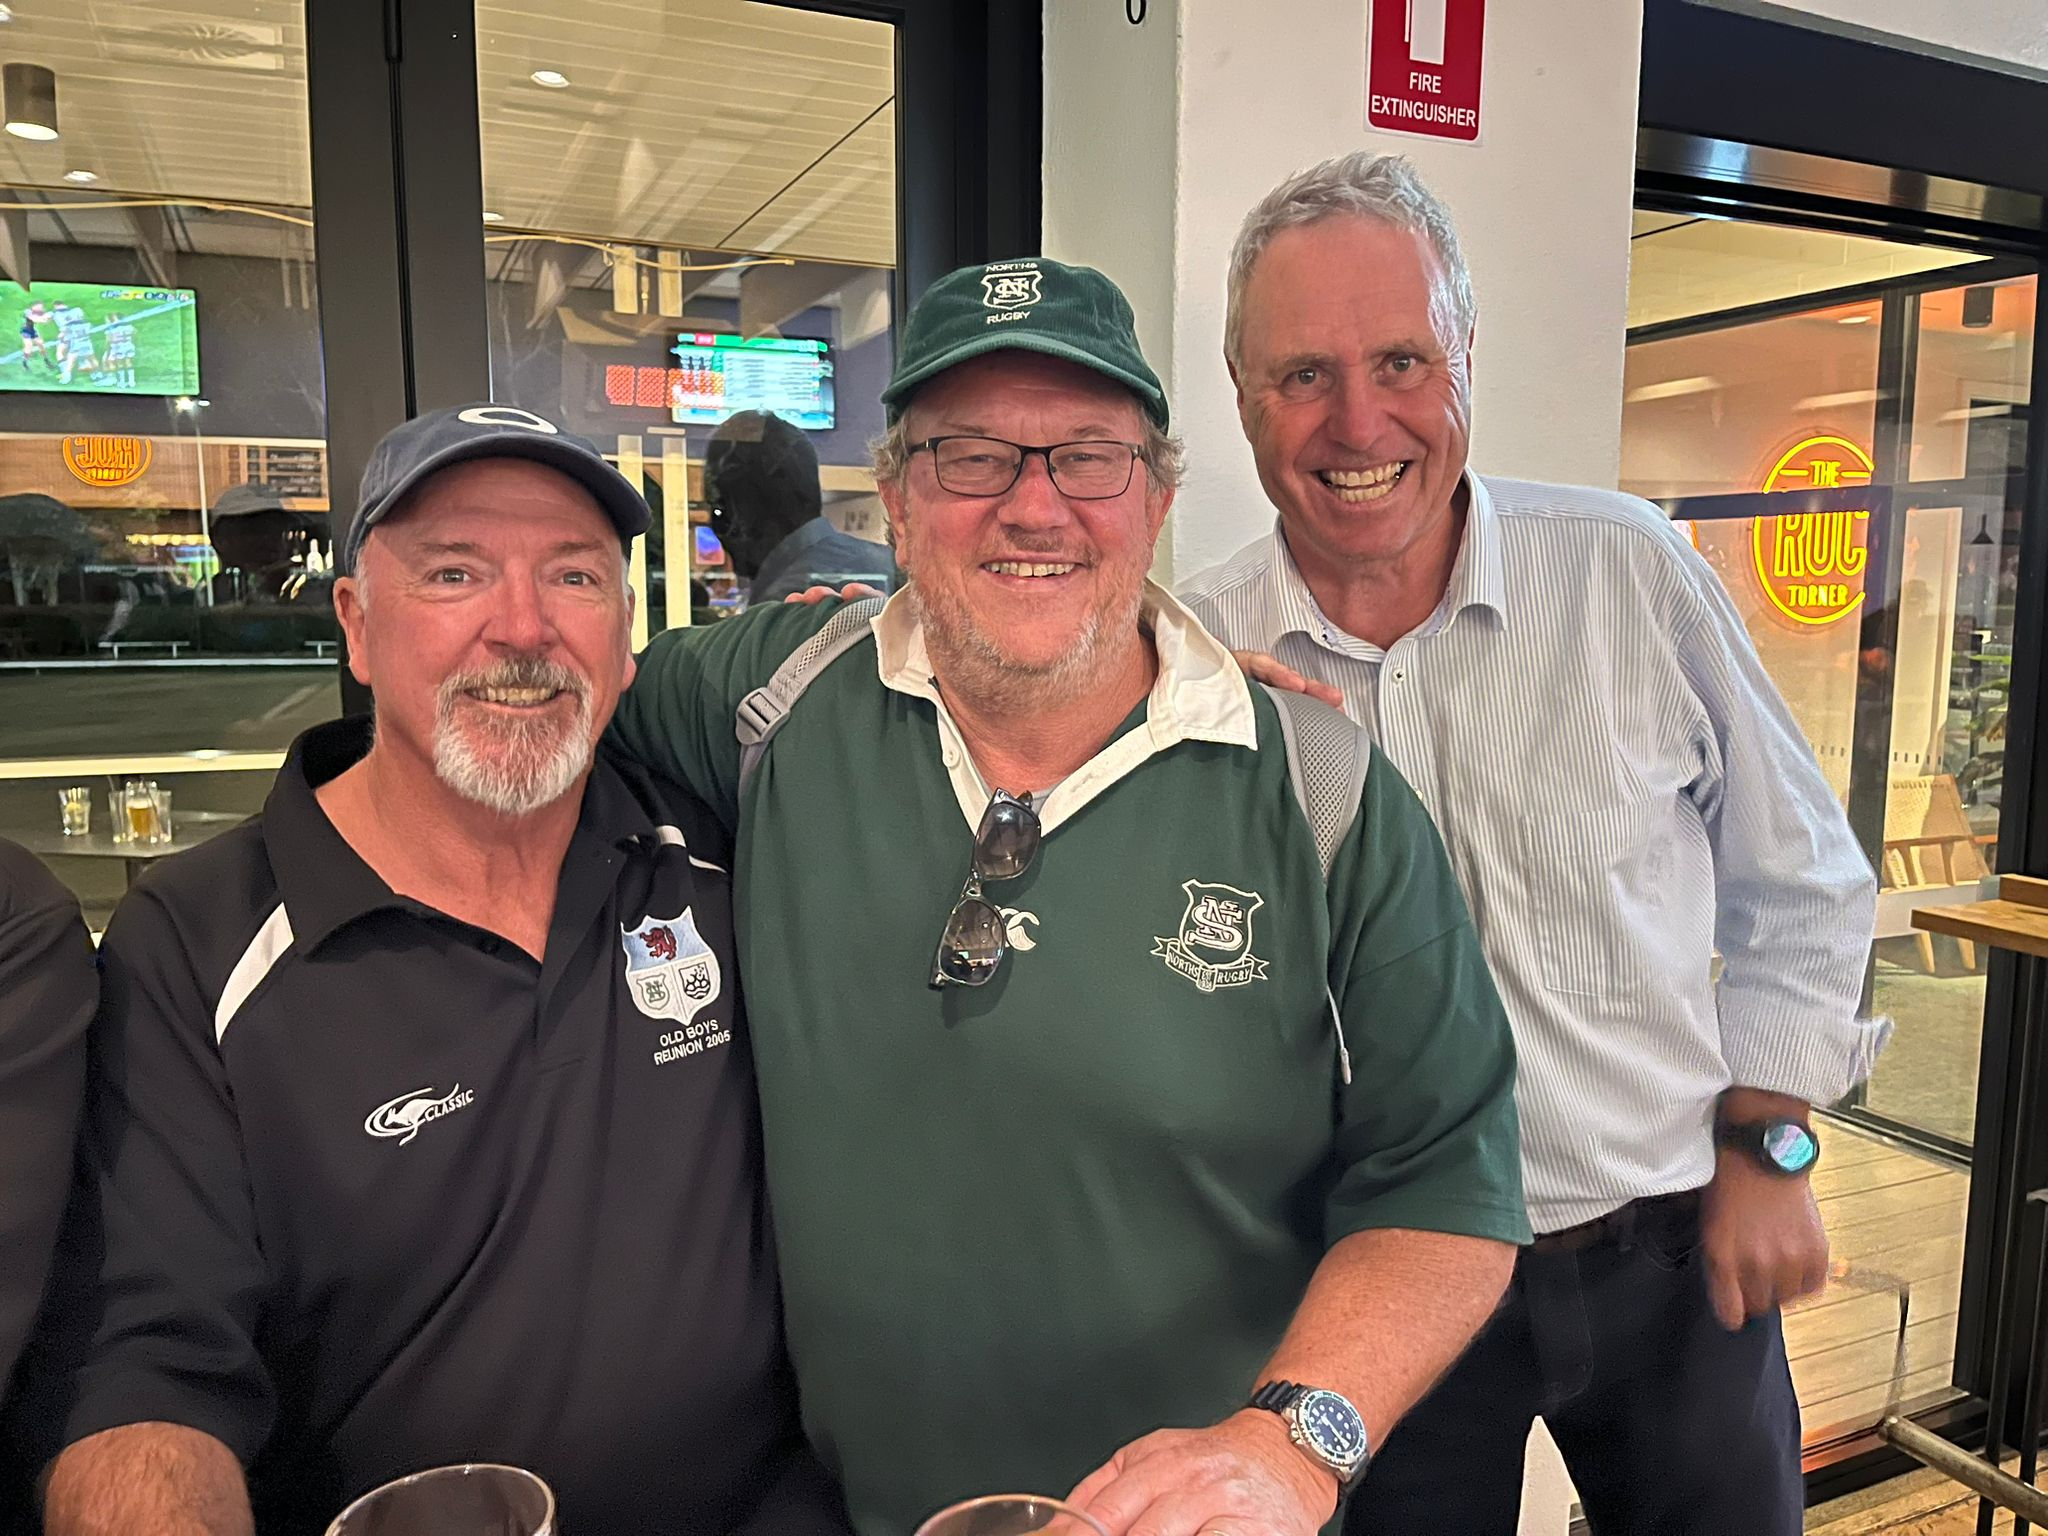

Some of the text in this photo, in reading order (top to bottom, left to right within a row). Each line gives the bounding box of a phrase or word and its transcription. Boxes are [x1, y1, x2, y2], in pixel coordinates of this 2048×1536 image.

[1409, 71, 1442, 94] FIRE
[1371, 94, 1477, 128] EXTINGUISHER
[985, 262, 1038, 272] NORTHS
[986, 311, 1031, 325] RUGBY
[1810, 460, 1842, 488] THE
[1786, 583, 1850, 607] TURNER
[1167, 951, 1200, 978] NORTHS
[1216, 968, 1251, 984] RUGBY
[659, 1018, 719, 1048] OLD BOYS
[653, 1029, 732, 1066] REUNION 2005
[424, 1089, 475, 1122] CLASSIC
